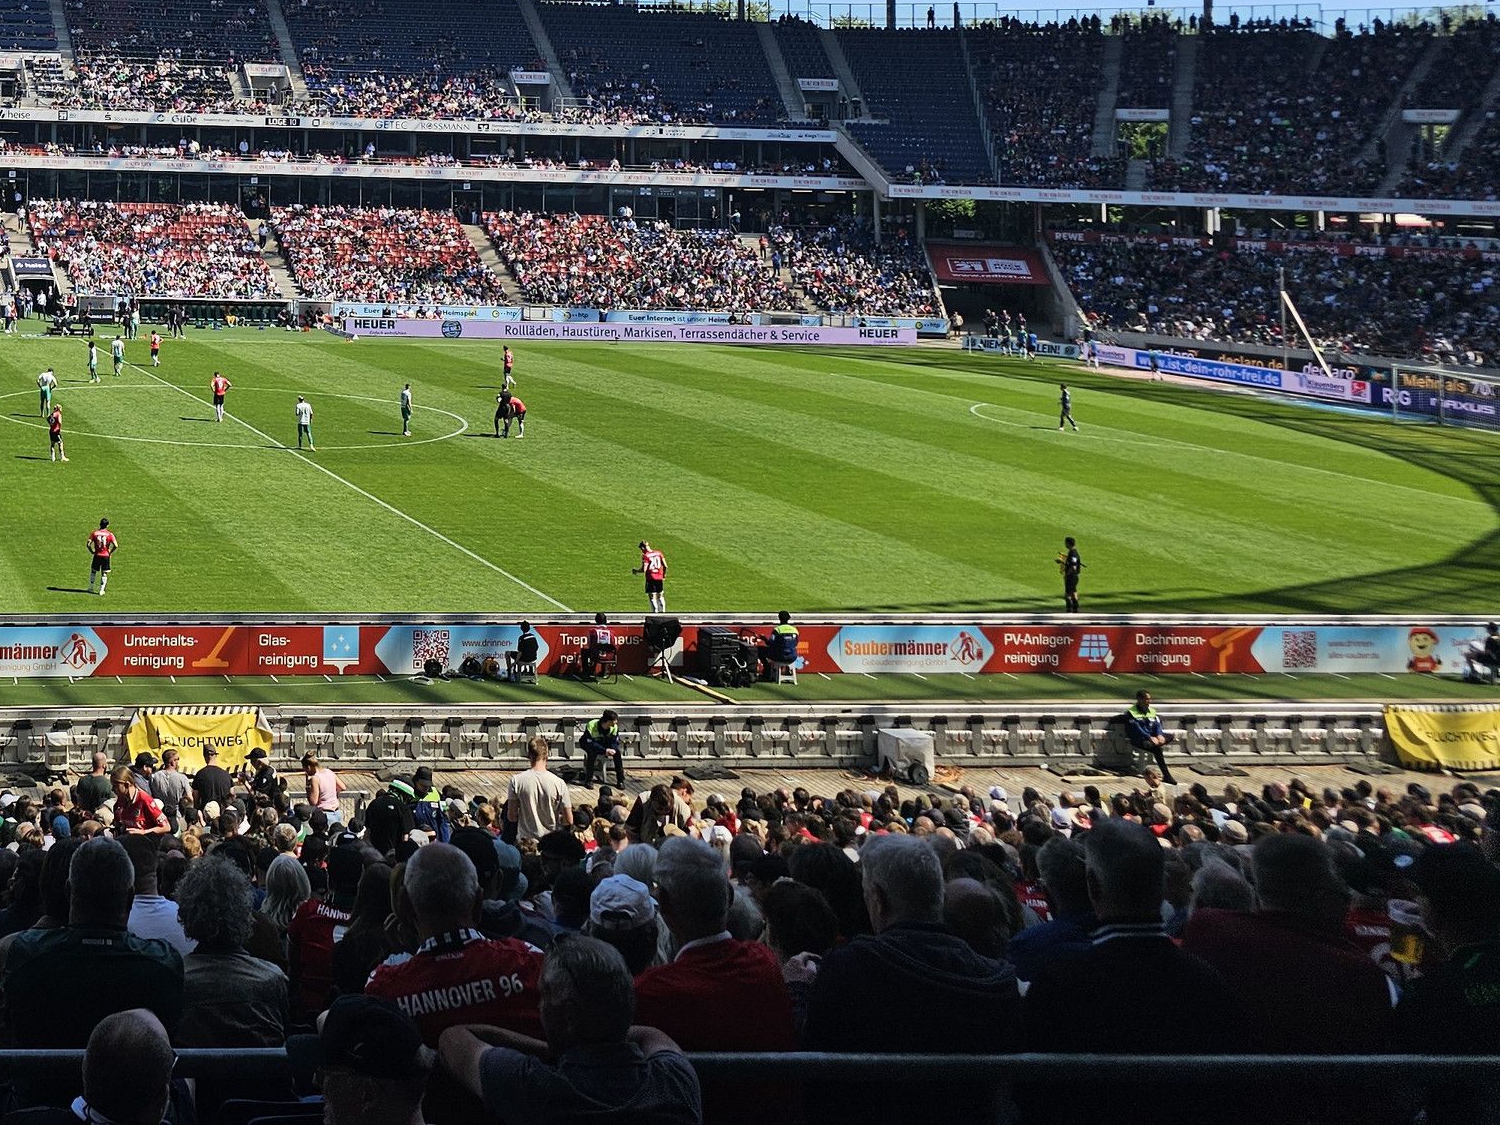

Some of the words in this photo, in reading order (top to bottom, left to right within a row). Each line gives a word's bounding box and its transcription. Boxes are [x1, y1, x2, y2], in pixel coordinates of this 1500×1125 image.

[7, 111, 31, 120] heise
[268, 118, 286, 126] LOGE
[374, 120, 407, 130] GETEC
[420, 122, 470, 131] ROSSMANN
[1054, 232, 1085, 242] REWE
[354, 320, 397, 330] HEUER
[628, 315, 646, 323] Euer
[646, 315, 676, 323] Internet
[504, 324, 559, 338] Rollläden,
[562, 326, 621, 339] Haustüren,
[624, 327, 676, 340] Markisen,
[680, 328, 768, 342] Terrassendächer
[770, 330, 778, 341] &
[781, 330, 820, 342] Service
[859, 328, 899, 339] HEUER
[123, 634, 199, 647] Unterhalts-
[258, 633, 291, 647] Glas-
[1003, 633, 1074, 648] PV-Anlagen-
[1135, 633, 1207, 646] Dachrinnen-
[843, 639, 950, 657] Saubermänner
[123, 653, 185, 670] reinigung
[258, 652, 318, 669] reinigung
[1003, 652, 1060, 667] reinigung
[1135, 652, 1191, 667] reinigung
[32, 662, 58, 672] GmbH
[396, 977, 497, 1018] HANNOVER
[499, 972, 525, 998] 96
